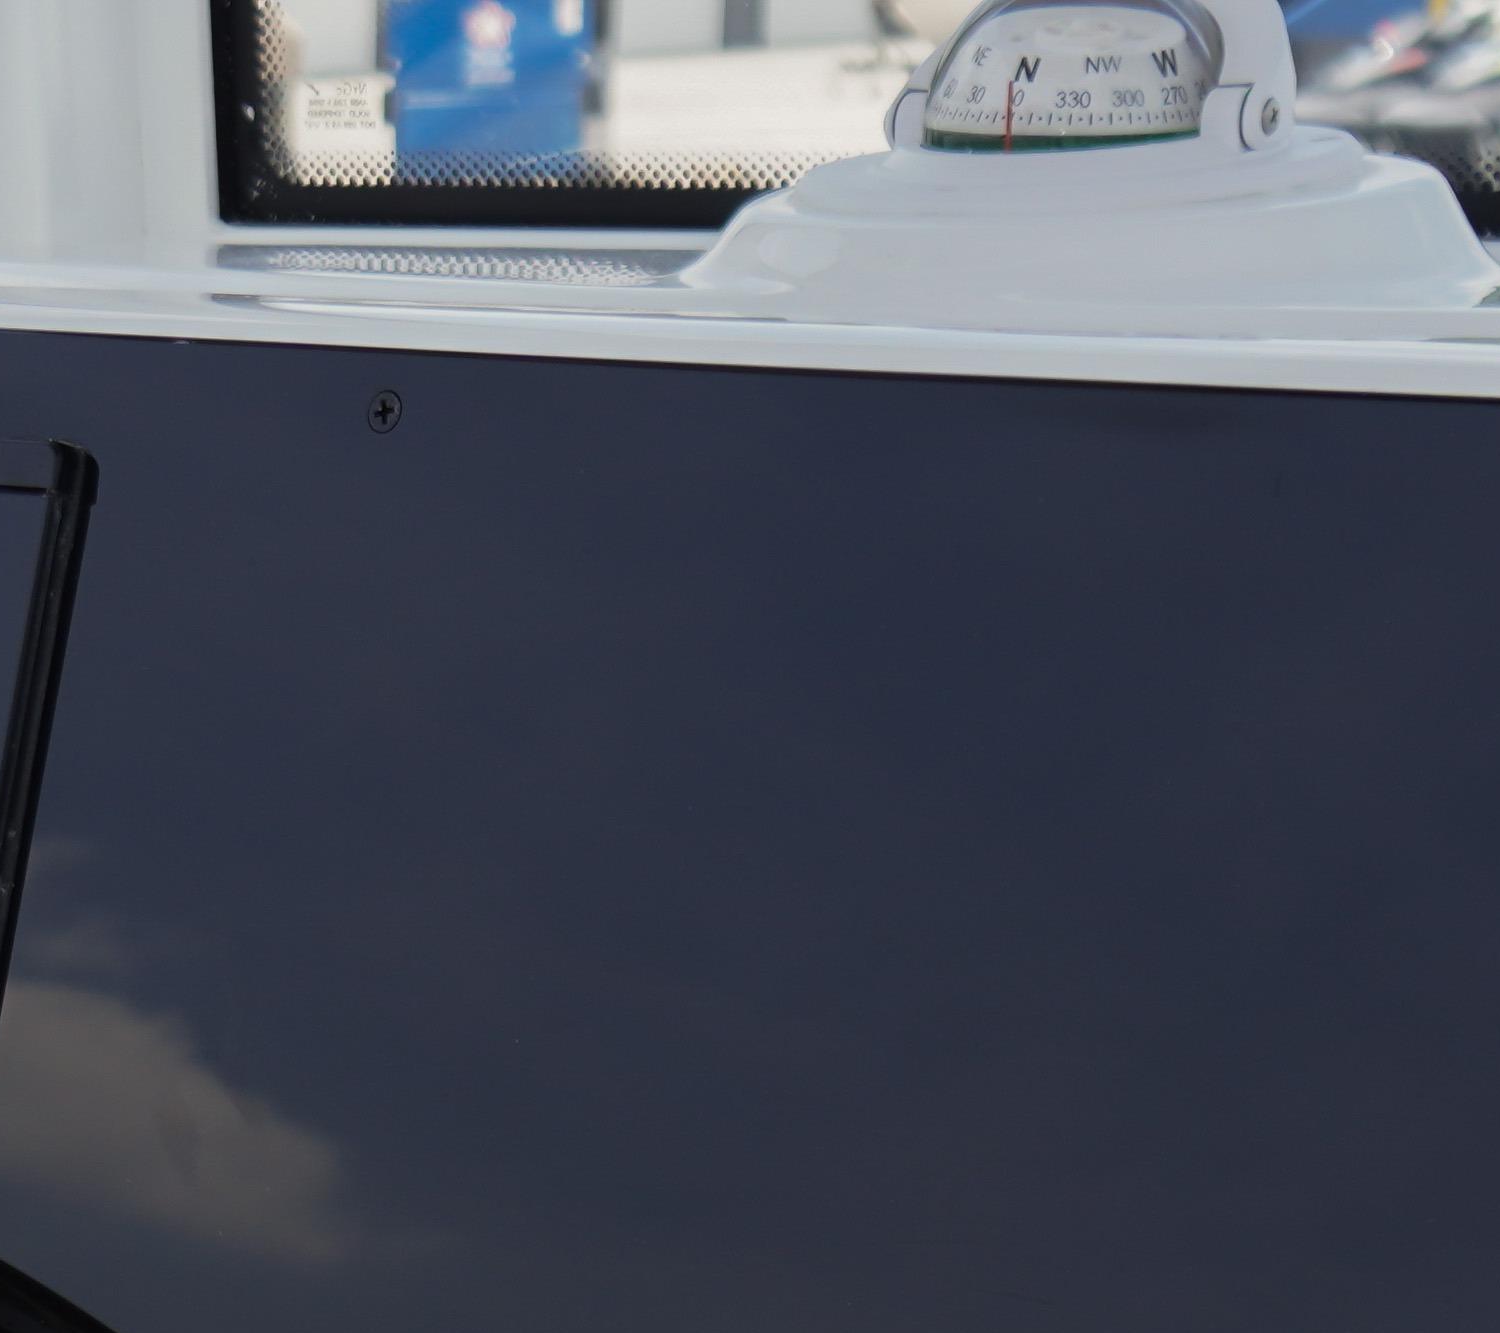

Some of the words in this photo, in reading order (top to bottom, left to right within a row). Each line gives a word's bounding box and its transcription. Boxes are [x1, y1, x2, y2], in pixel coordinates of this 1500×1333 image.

[1014, 56, 1041, 83] N
[1085, 55, 1122, 74] NW
[1151, 49, 1178, 78] W
[966, 85, 986, 104] 30
[1055, 91, 1092, 109] 330
[1112, 90, 1144, 107] 300
[1161, 85, 1188, 106] 270
